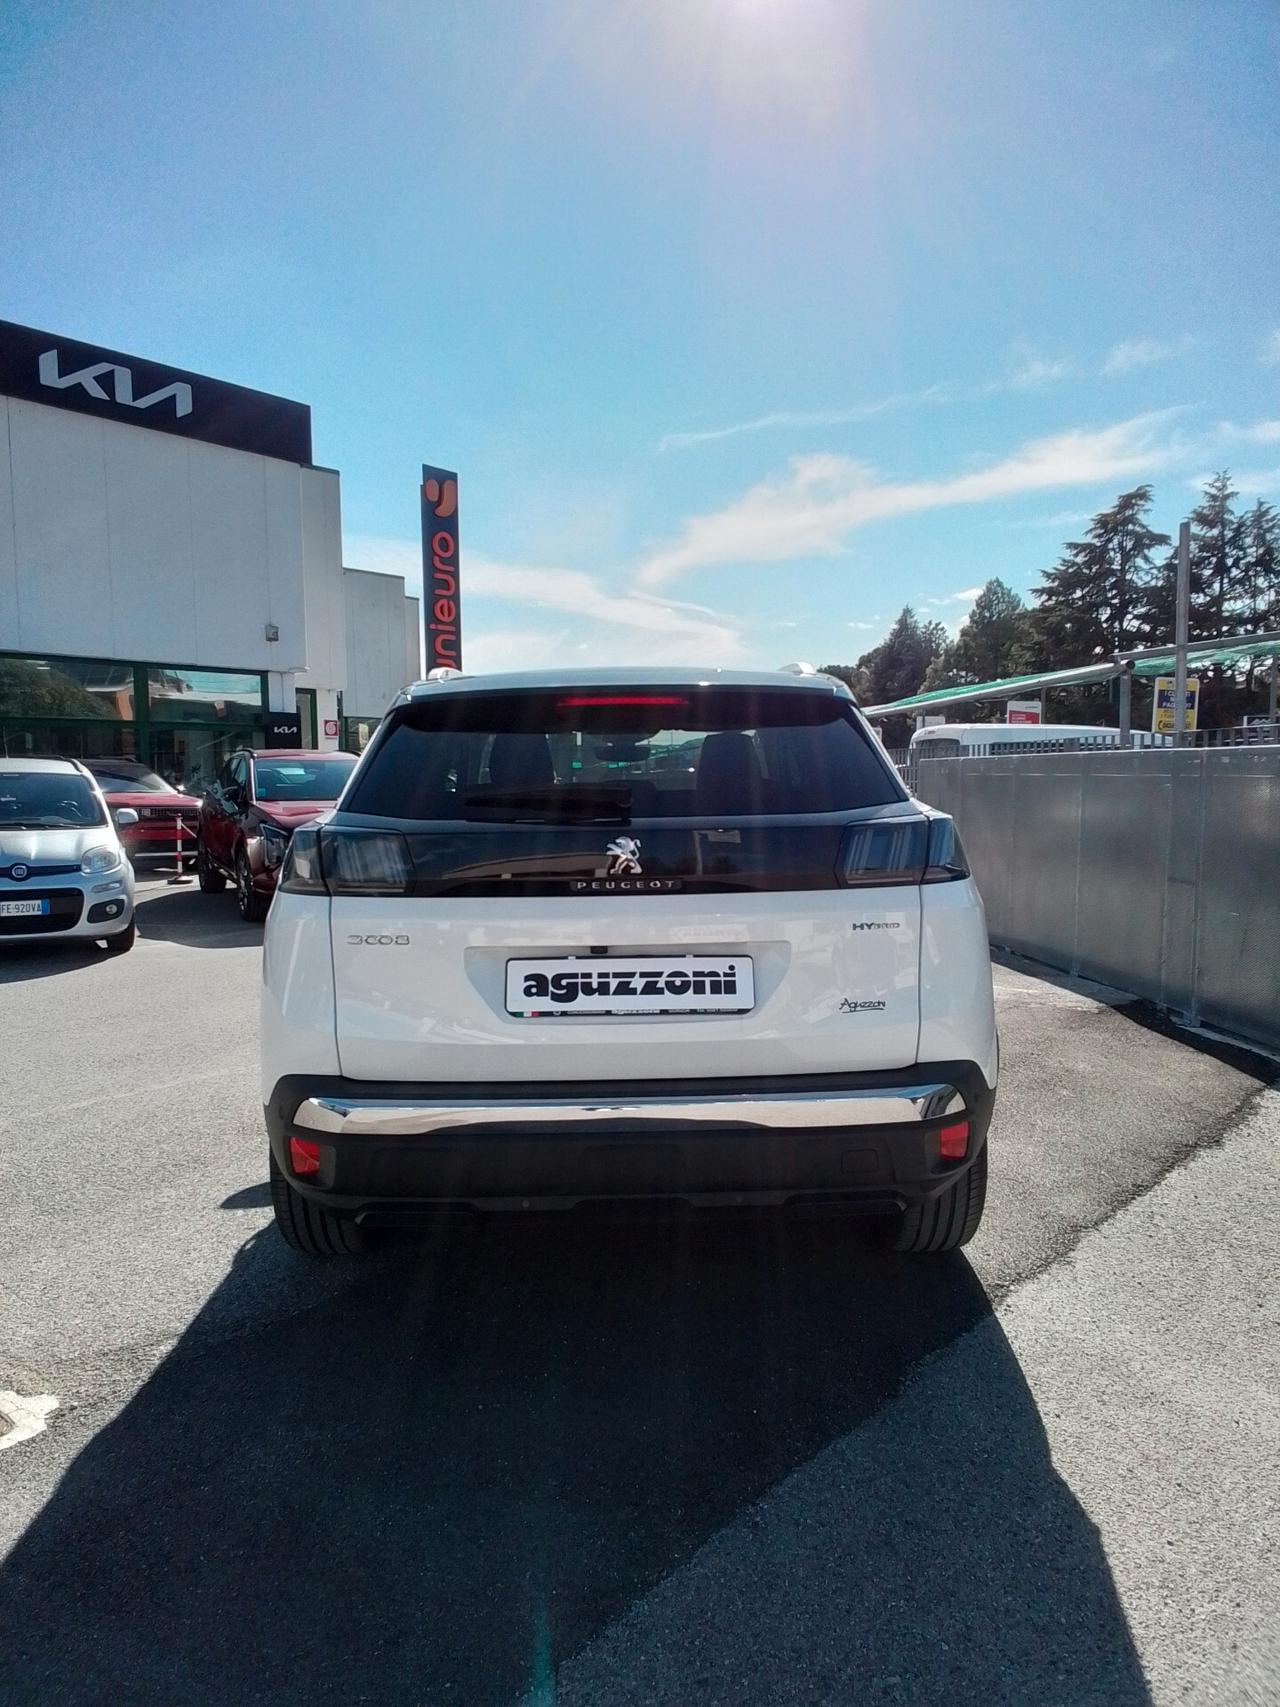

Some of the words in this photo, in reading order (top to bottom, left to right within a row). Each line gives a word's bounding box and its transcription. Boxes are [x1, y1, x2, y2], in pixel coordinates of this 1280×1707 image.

[39, 349, 193, 418] KIA
[575, 880, 675, 890] PEUGEOT
[523, 964, 737, 1004] aguzzoni
